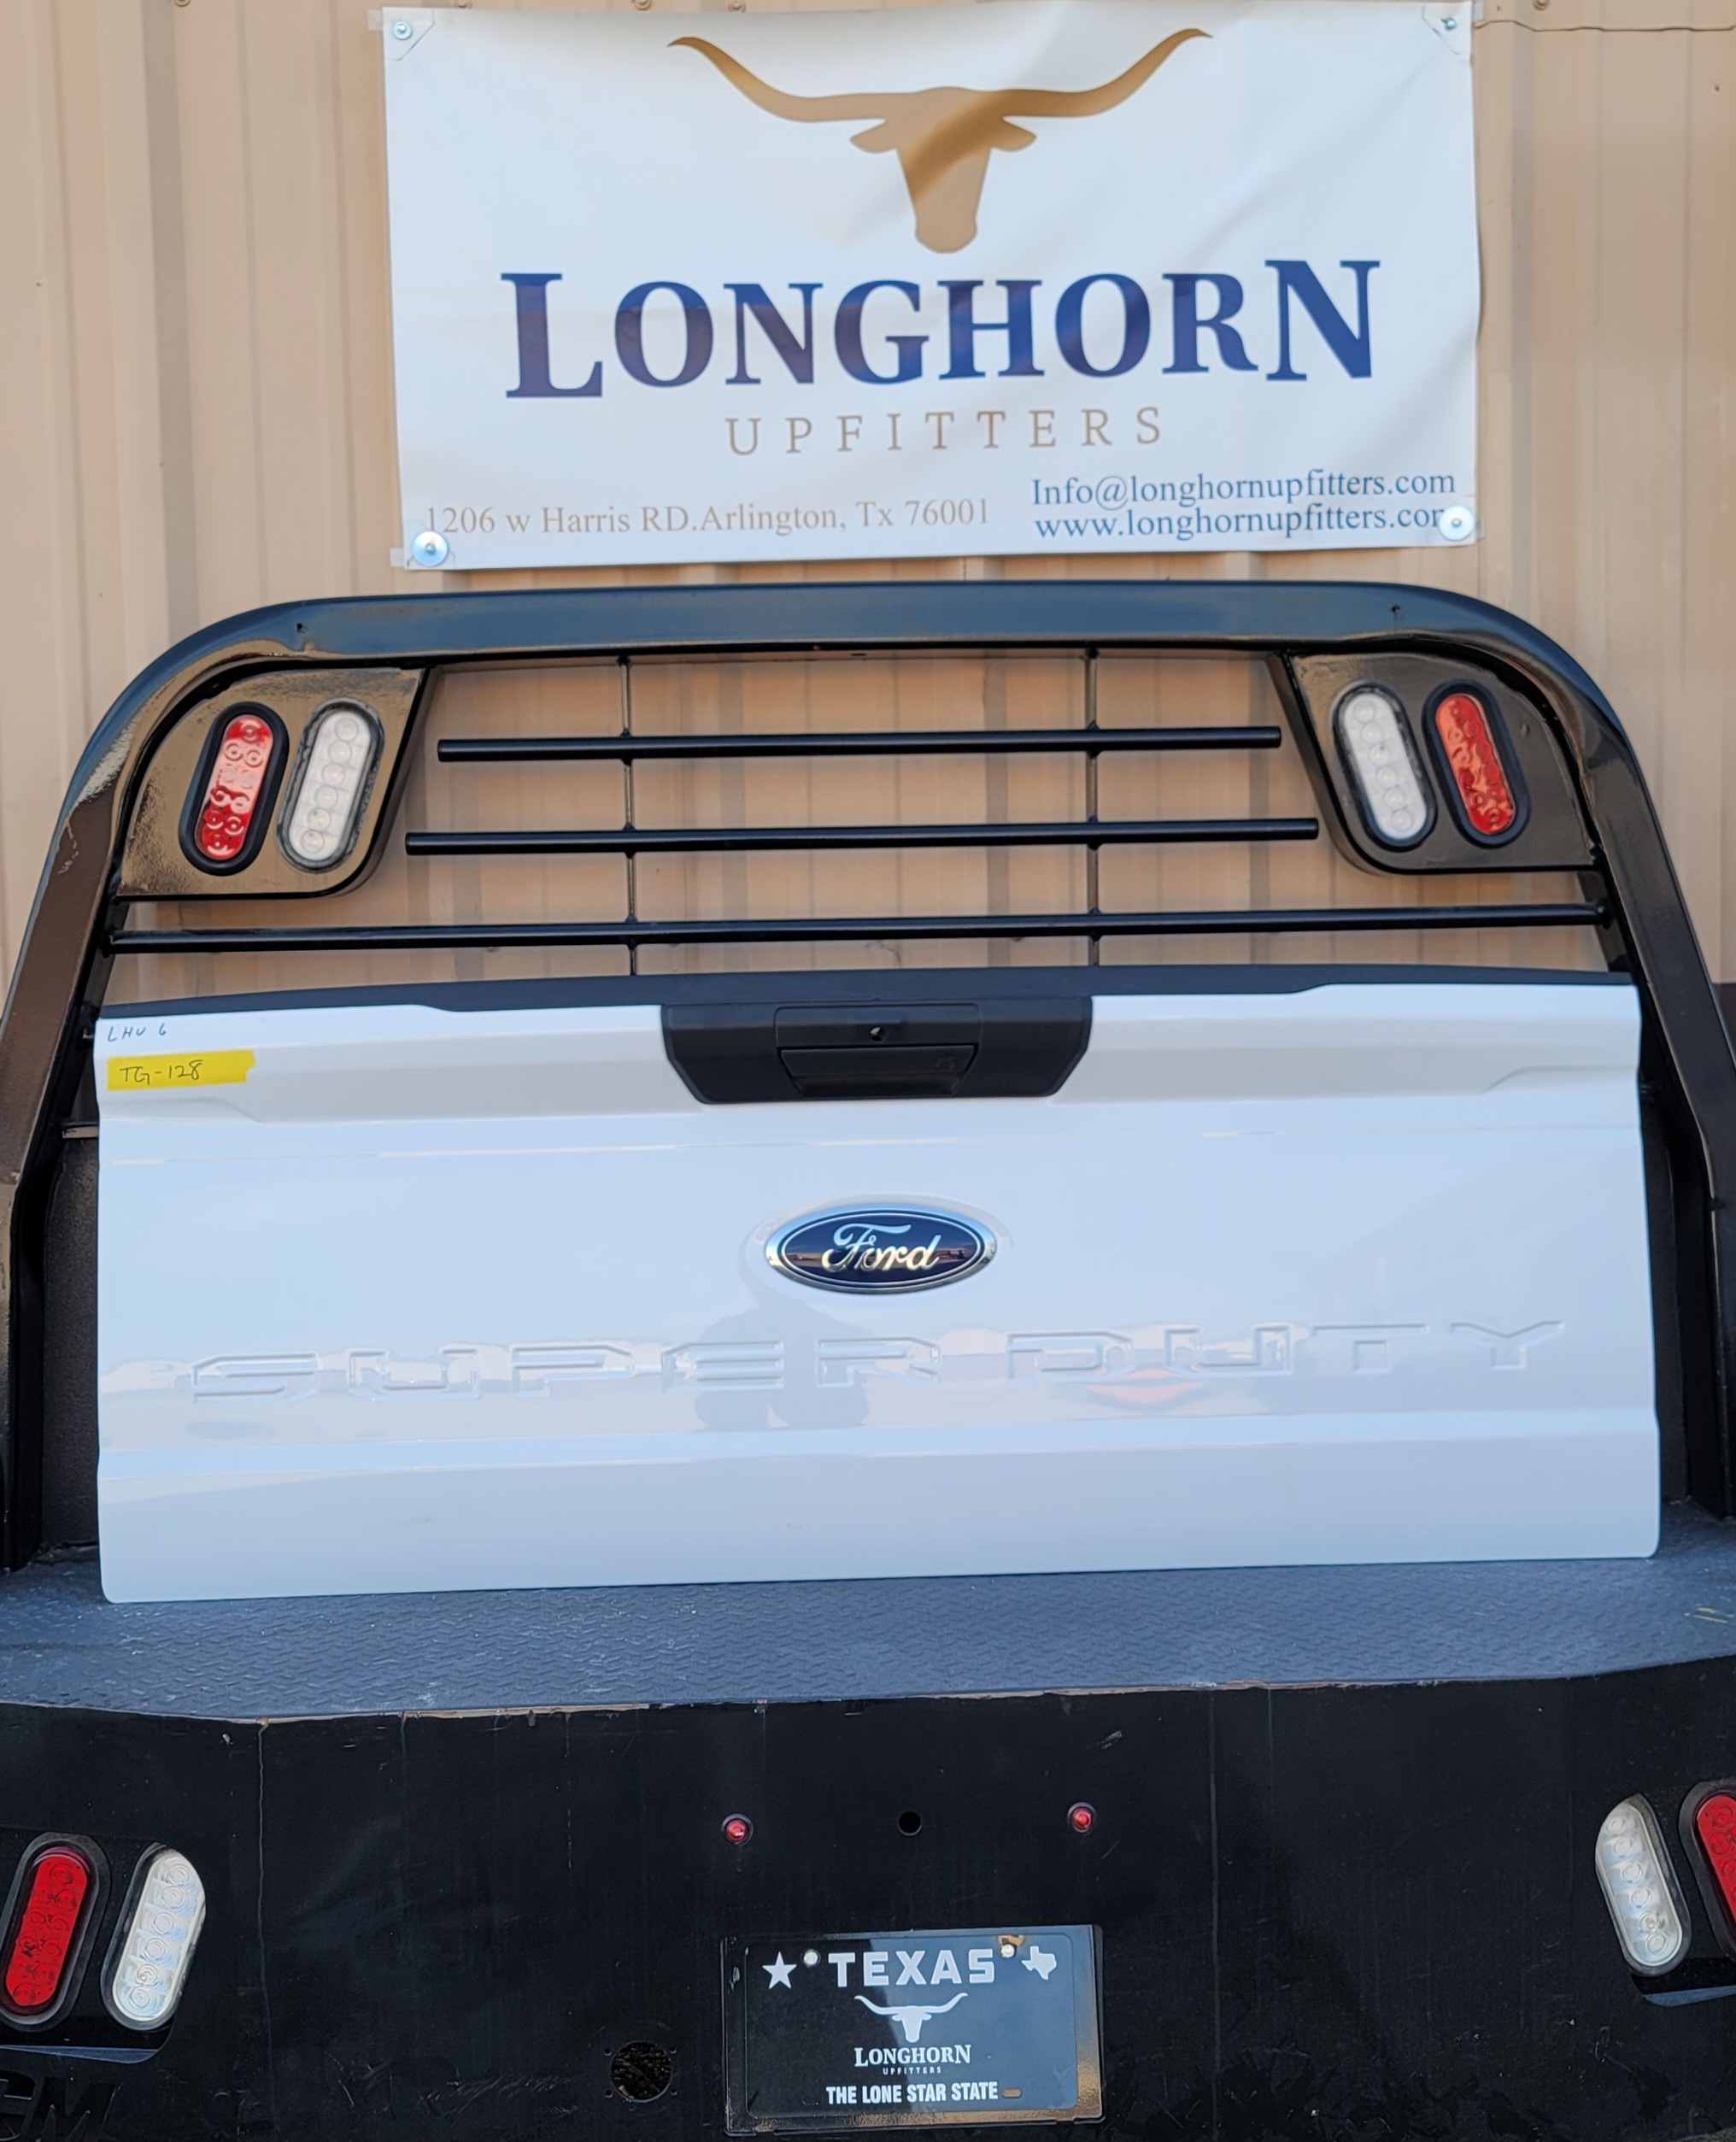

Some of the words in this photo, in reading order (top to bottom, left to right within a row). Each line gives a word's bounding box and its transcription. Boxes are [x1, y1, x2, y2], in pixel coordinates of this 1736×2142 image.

[501, 260, 1381, 399] LONGHORN
[725, 407, 1162, 455] UPFITTERS
[1030, 468, 1457, 511] Info@longhornupfitters.com
[427, 506, 496, 534] 1206
[506, 513, 531, 533] w
[541, 506, 630, 533] Harris
[854, 501, 894, 527] Tx
[905, 498, 988, 526] 76001
[119, 1059, 204, 1086] TG-128
[821, 1223, 942, 1272] Ford
[190, 1337, 941, 1404] SUPER
[1007, 1318, 1566, 1382] DUTY
[828, 1948, 995, 1987] TEXAS
[853, 2044, 972, 2068] LONGHORN
[883, 2066, 941, 2075] UPFITTERS
[826, 2086, 857, 2104] THE
[861, 2084, 903, 2104] LONE
[906, 2082, 947, 2103] STAR
[951, 2081, 999, 2101] STATE
